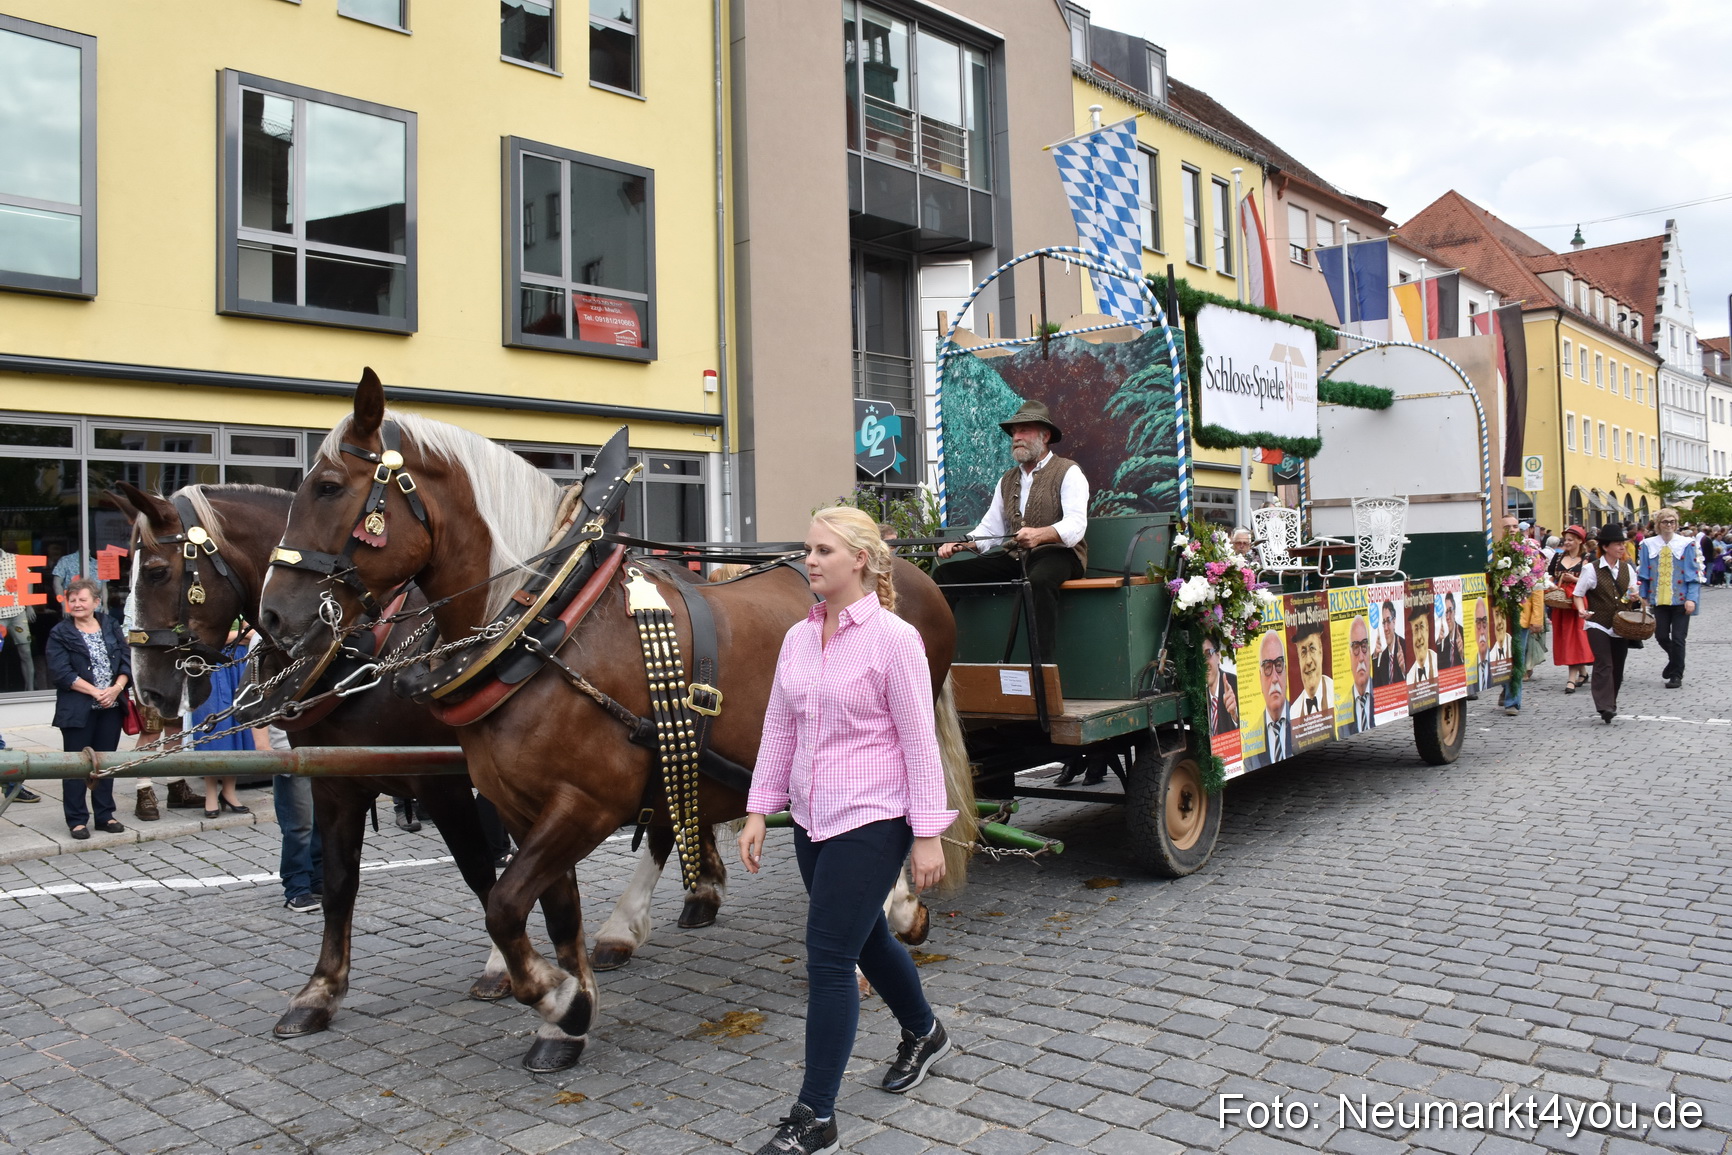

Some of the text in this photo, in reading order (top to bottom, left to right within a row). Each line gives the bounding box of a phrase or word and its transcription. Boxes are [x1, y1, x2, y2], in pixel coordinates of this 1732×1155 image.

[583, 314, 594, 322] Tel.
[1205, 355, 1285, 410] Schloss-Spiele
[861, 415, 886, 458] G2
[1282, 456, 1294, 472] G2
[1367, 585, 1404, 604] SEIDENSCHNUR
[1461, 576, 1487, 593] RUSSEK
[1329, 588, 1368, 612] RUSSEK
[1260, 600, 1283, 623] SEK
